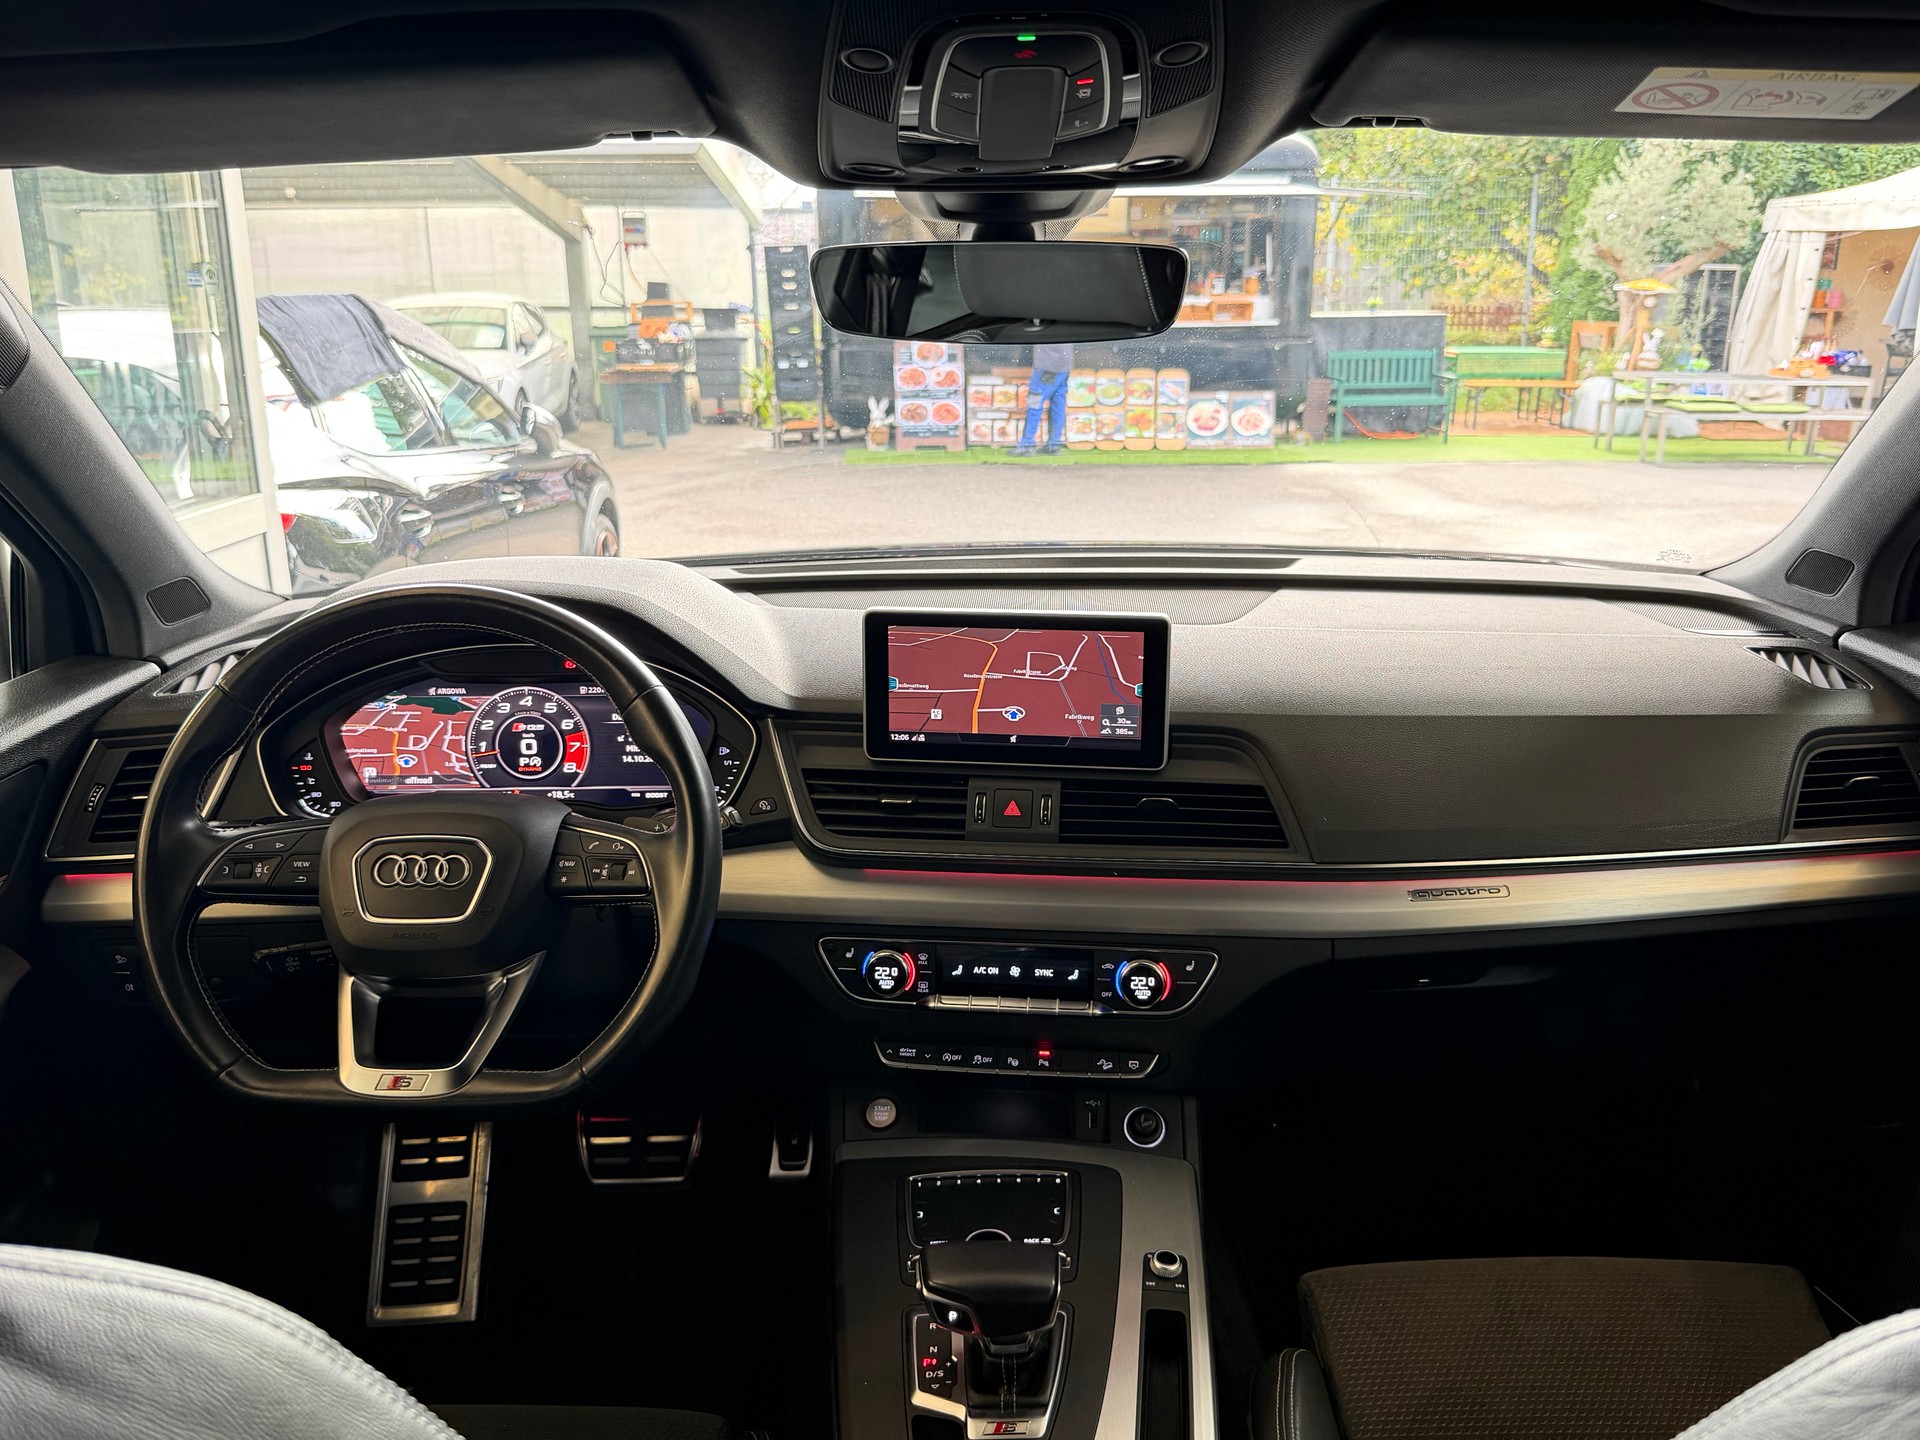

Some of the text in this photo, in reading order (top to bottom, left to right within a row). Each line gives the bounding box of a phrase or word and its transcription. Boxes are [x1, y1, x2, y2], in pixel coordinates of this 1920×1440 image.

[1769, 72, 1858, 82] AIRBAG
[437, 687, 466, 695] ARGOVIA
[519, 696, 533, 706] 4
[496, 703, 511, 713] 3
[544, 703, 558, 713] 5
[1065, 713, 1095, 721] Fabrikweg
[480, 719, 494, 730] 2
[561, 719, 575, 730] 6
[890, 733, 910, 741] 12:06
[478, 741, 487, 751] 1
[520, 738, 538, 755] 0
[569, 741, 581, 752] 7
[563, 762, 576, 773] 8
[1416, 887, 1501, 899] quattro
[973, 966, 999, 975] A/C ON
[1034, 968, 1054, 977] SYNC
[948, 1310, 957, 1322] P
[929, 1345, 938, 1353] N
[925, 1369, 944, 1378] D/S
